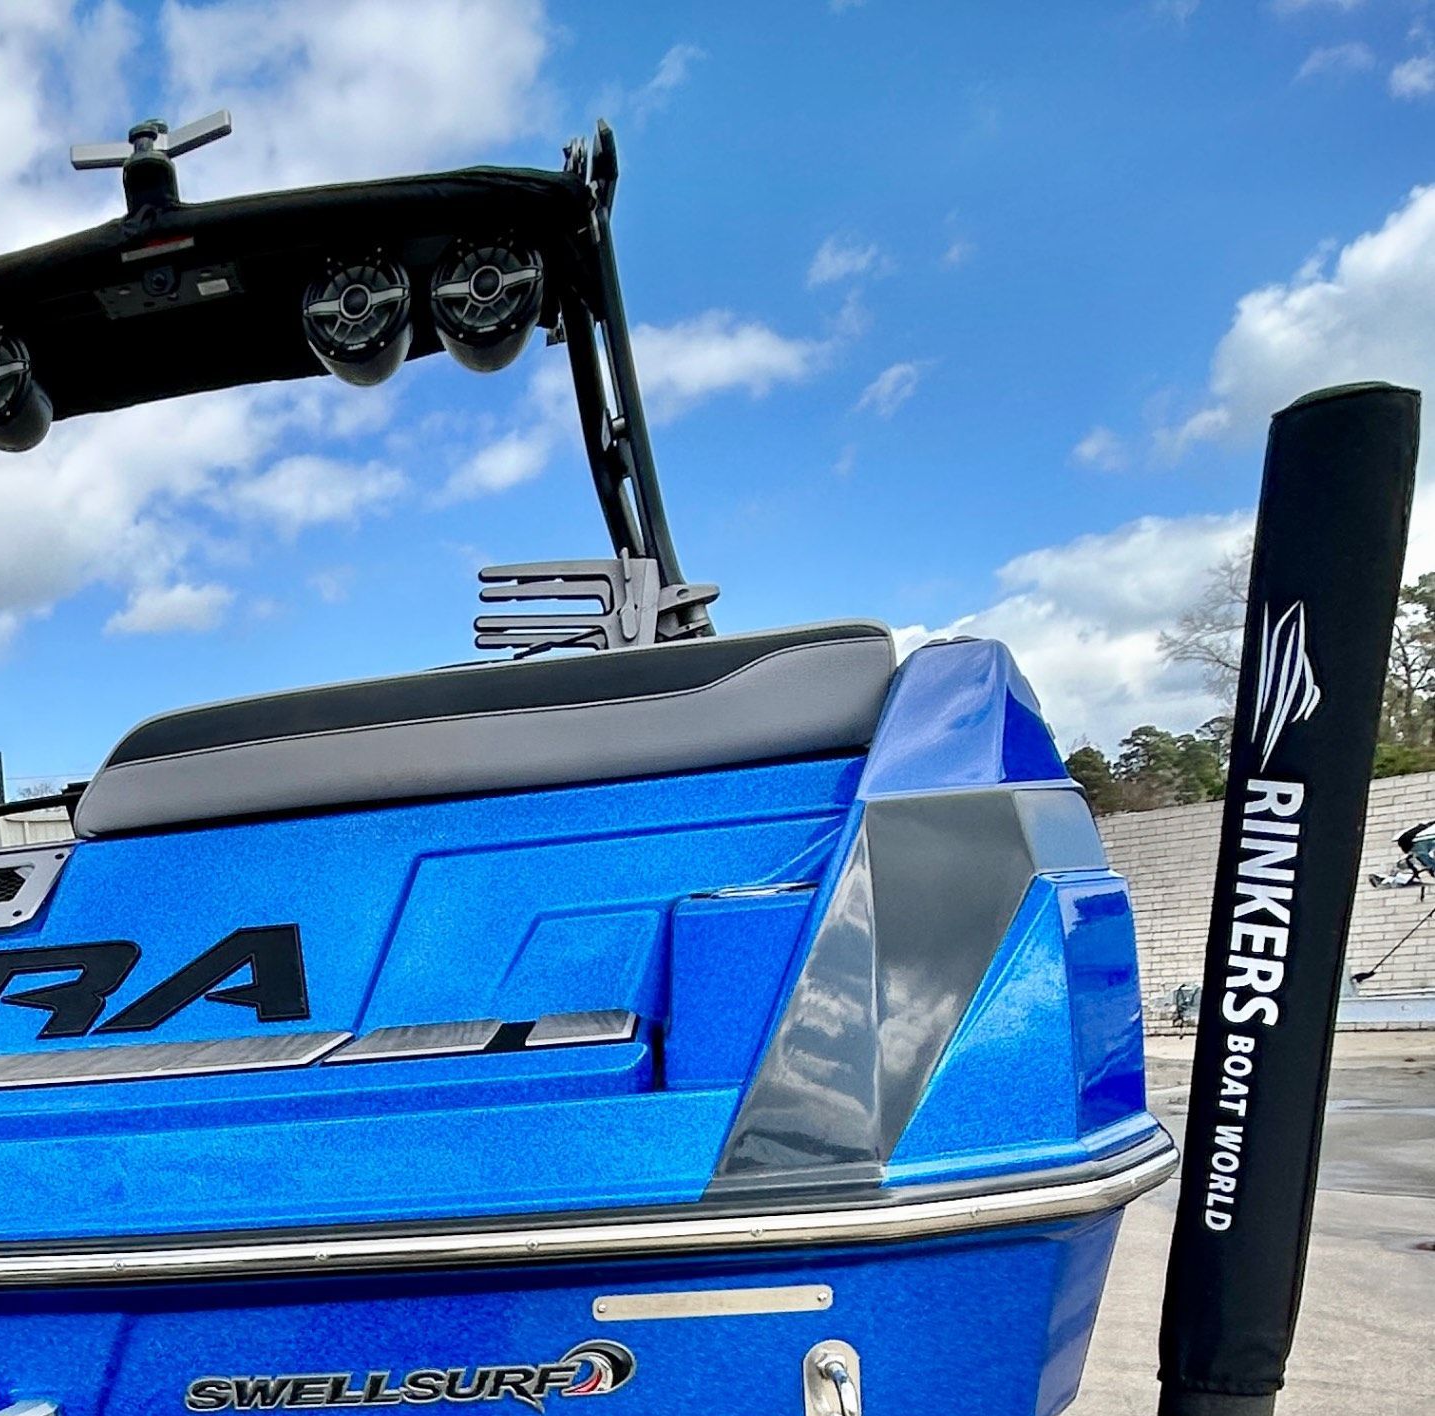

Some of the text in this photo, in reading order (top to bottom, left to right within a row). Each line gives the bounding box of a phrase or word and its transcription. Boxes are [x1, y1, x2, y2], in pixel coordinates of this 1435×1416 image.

[1205, 779, 1304, 1231] RINKERS BOAT WORLD
[186, 1362, 581, 1413] SWELLSURF
